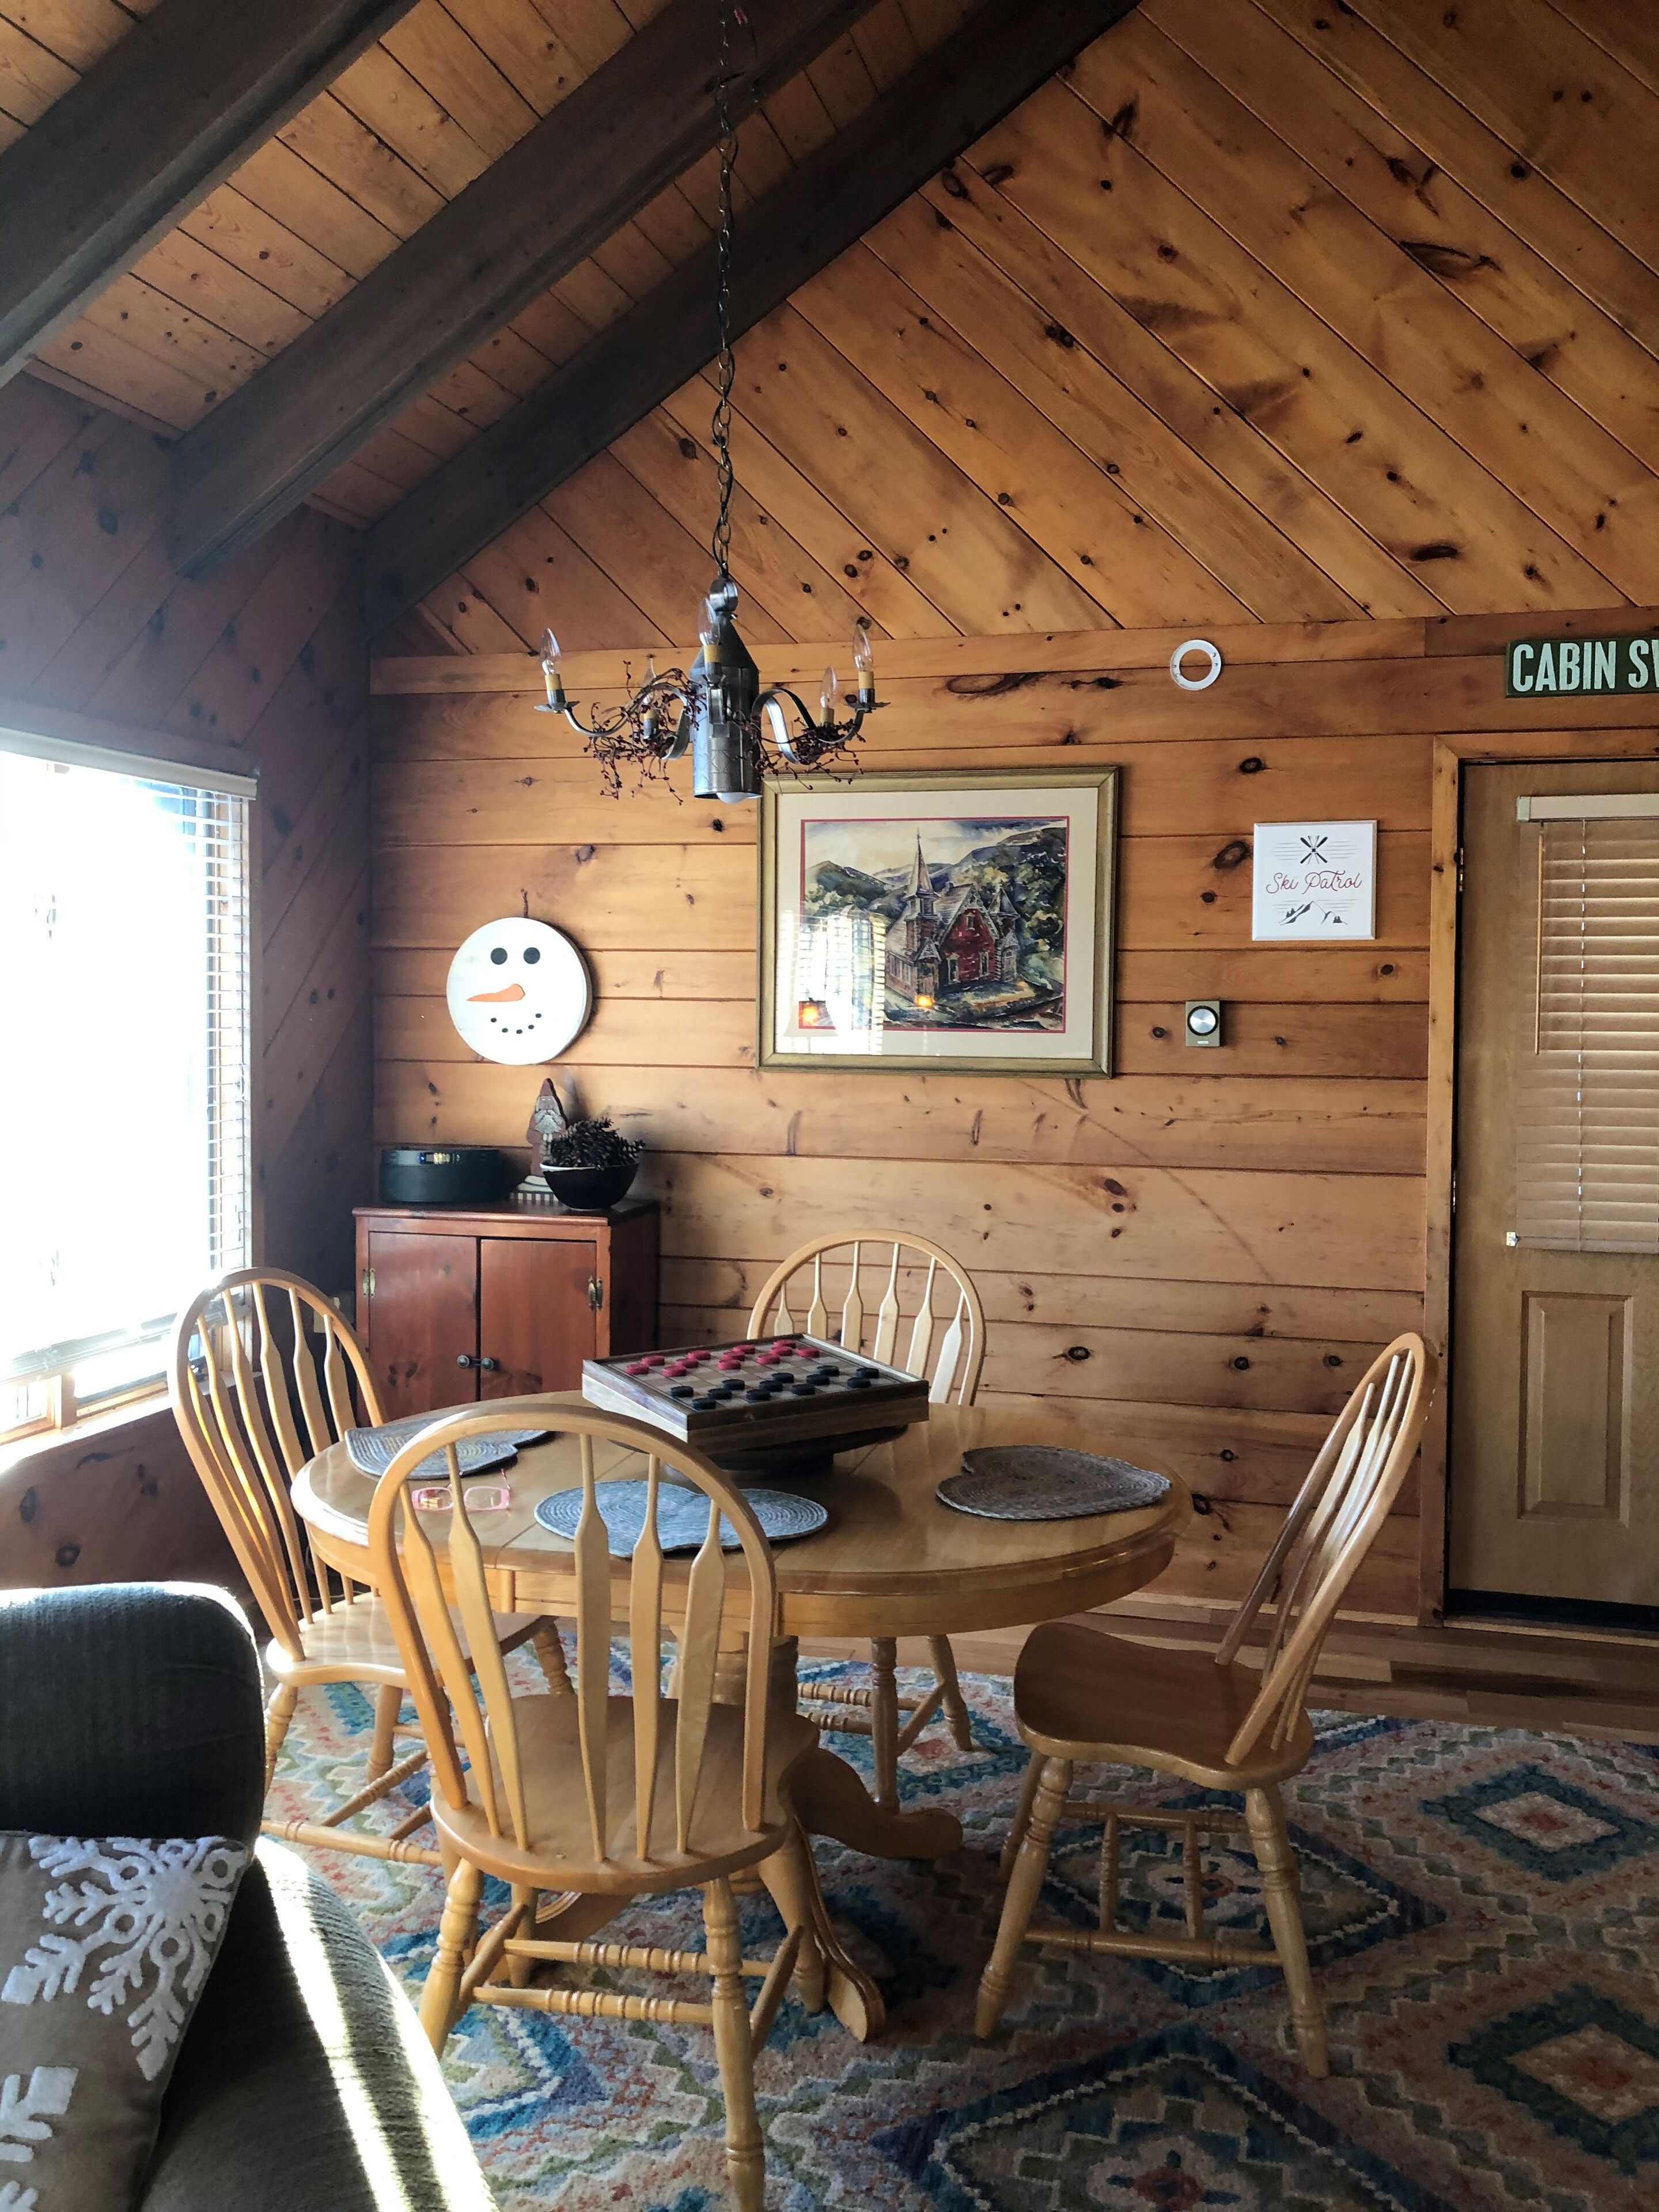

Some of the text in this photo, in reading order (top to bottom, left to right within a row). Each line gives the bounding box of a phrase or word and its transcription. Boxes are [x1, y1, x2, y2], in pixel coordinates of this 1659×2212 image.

[1513, 639, 1659, 692] CABIN S
[1266, 872, 1299, 894] Ski
